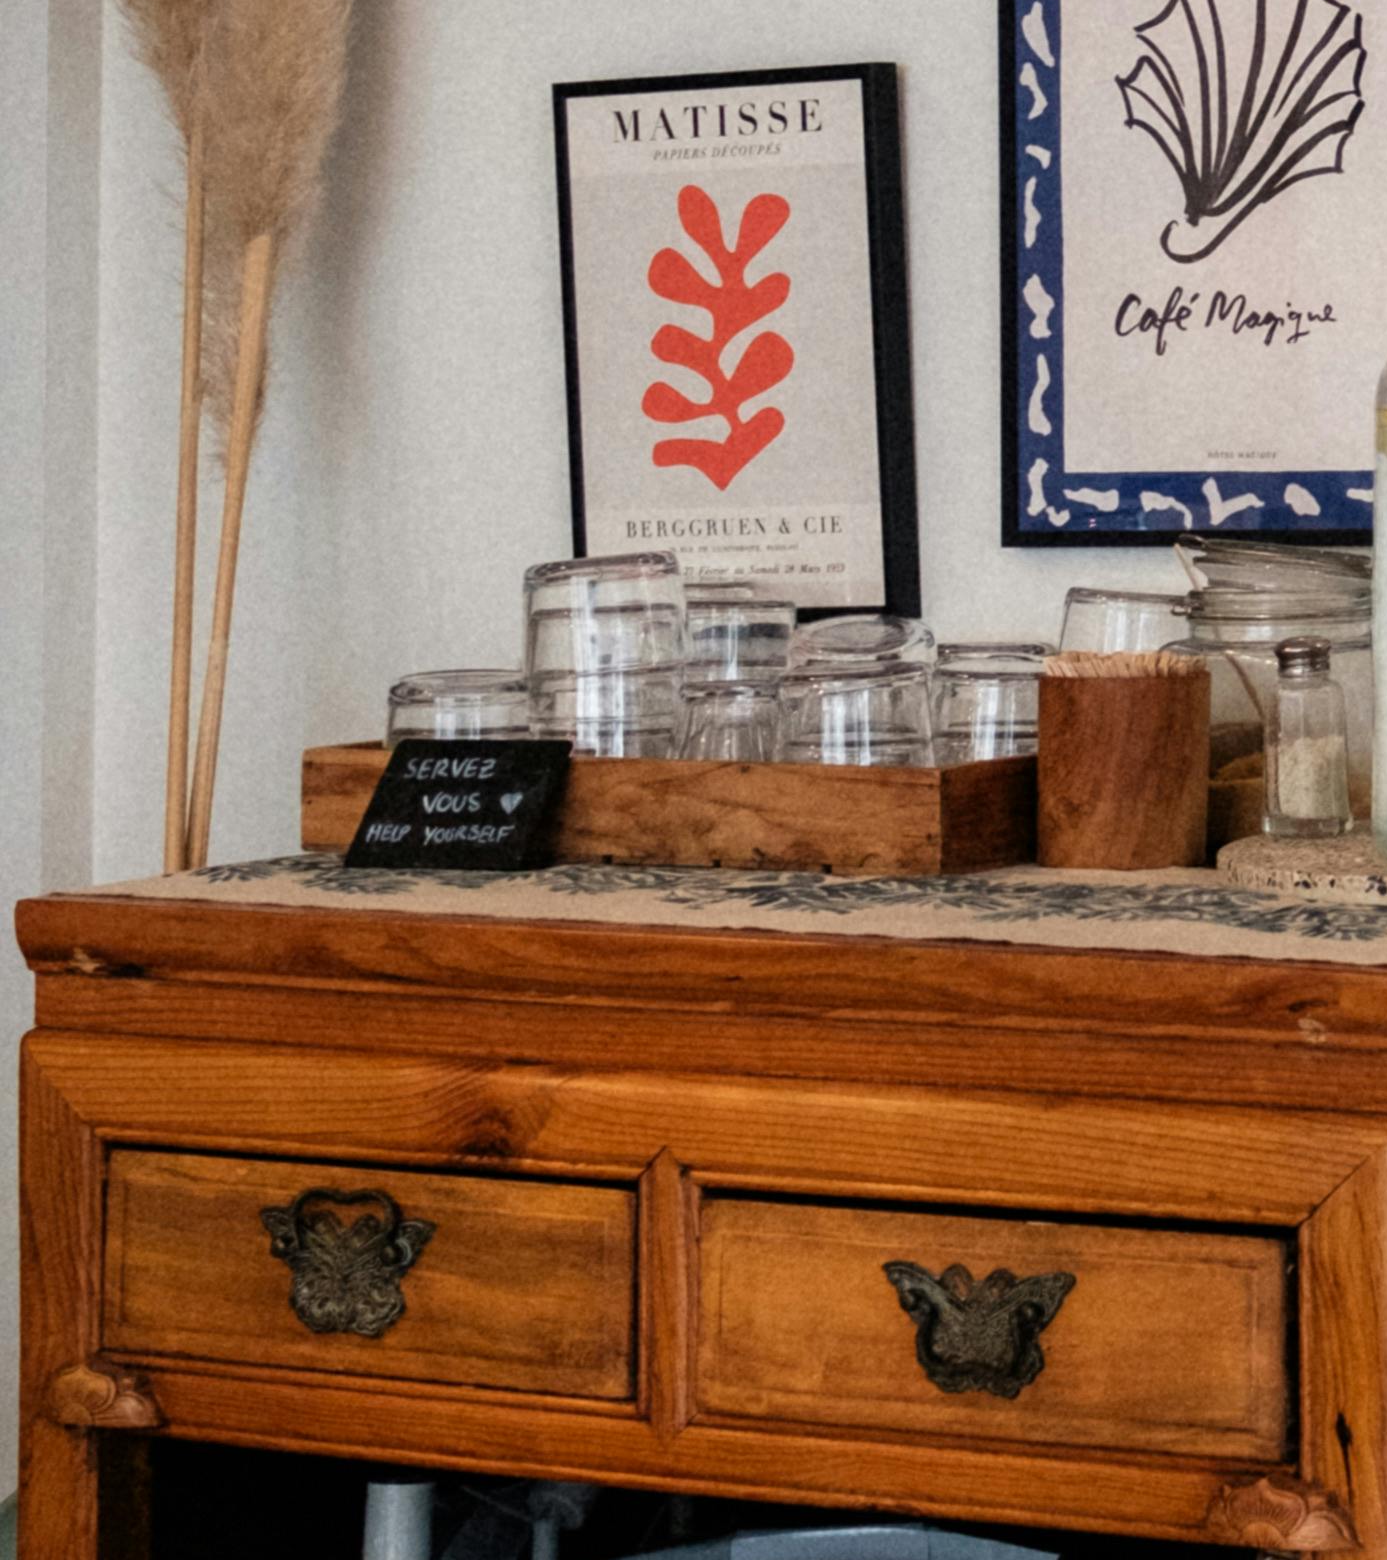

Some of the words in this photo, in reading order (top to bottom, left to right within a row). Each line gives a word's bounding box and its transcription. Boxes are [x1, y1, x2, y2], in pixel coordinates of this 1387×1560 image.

[612, 97, 824, 144] MATISSE
[652, 145, 706, 161] PAPIERS
[1114, 292, 1199, 357] Café
[1205, 289, 1338, 345] Magique
[626, 517, 767, 538] BERGGRUEN
[778, 516, 791, 535] &
[803, 515, 843, 534] CIE
[403, 757, 496, 780] SERVEZ
[422, 791, 481, 815] VOUS
[365, 824, 412, 845] HELP
[422, 824, 515, 846] YOURSELF
